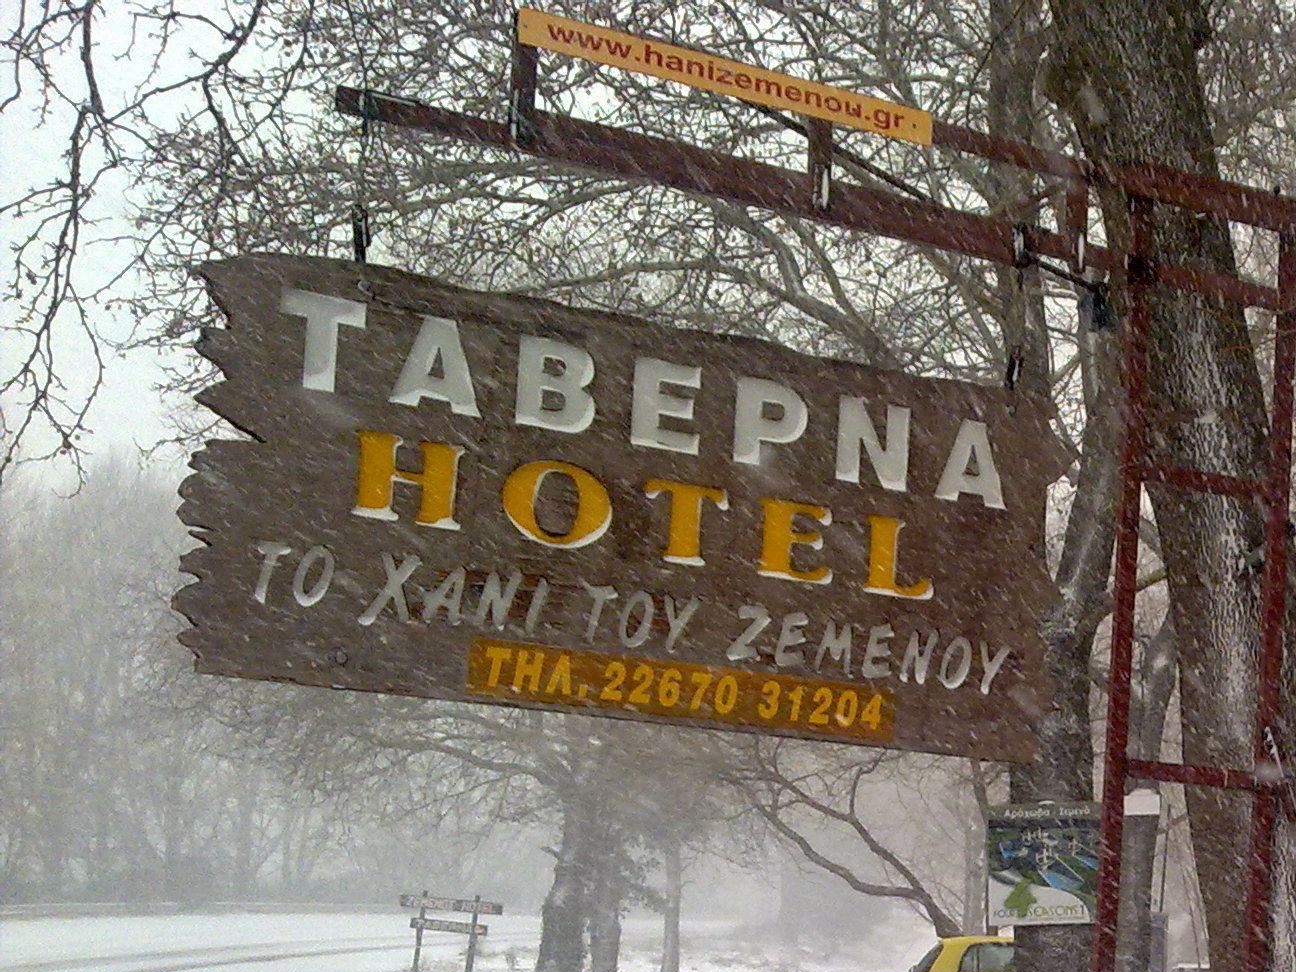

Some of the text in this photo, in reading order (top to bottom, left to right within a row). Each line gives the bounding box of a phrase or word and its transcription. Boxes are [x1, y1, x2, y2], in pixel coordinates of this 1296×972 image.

[281, 287, 1007, 510] ΤΑΒΕΡΝΑ
[351, 430, 933, 600] HOTEL
[255, 540, 1010, 695] ΤΟ ΧΑΝΙ ΤΟΥ ΖΕΜΕΝΟΥ
[758, 680, 883, 730] 31204
